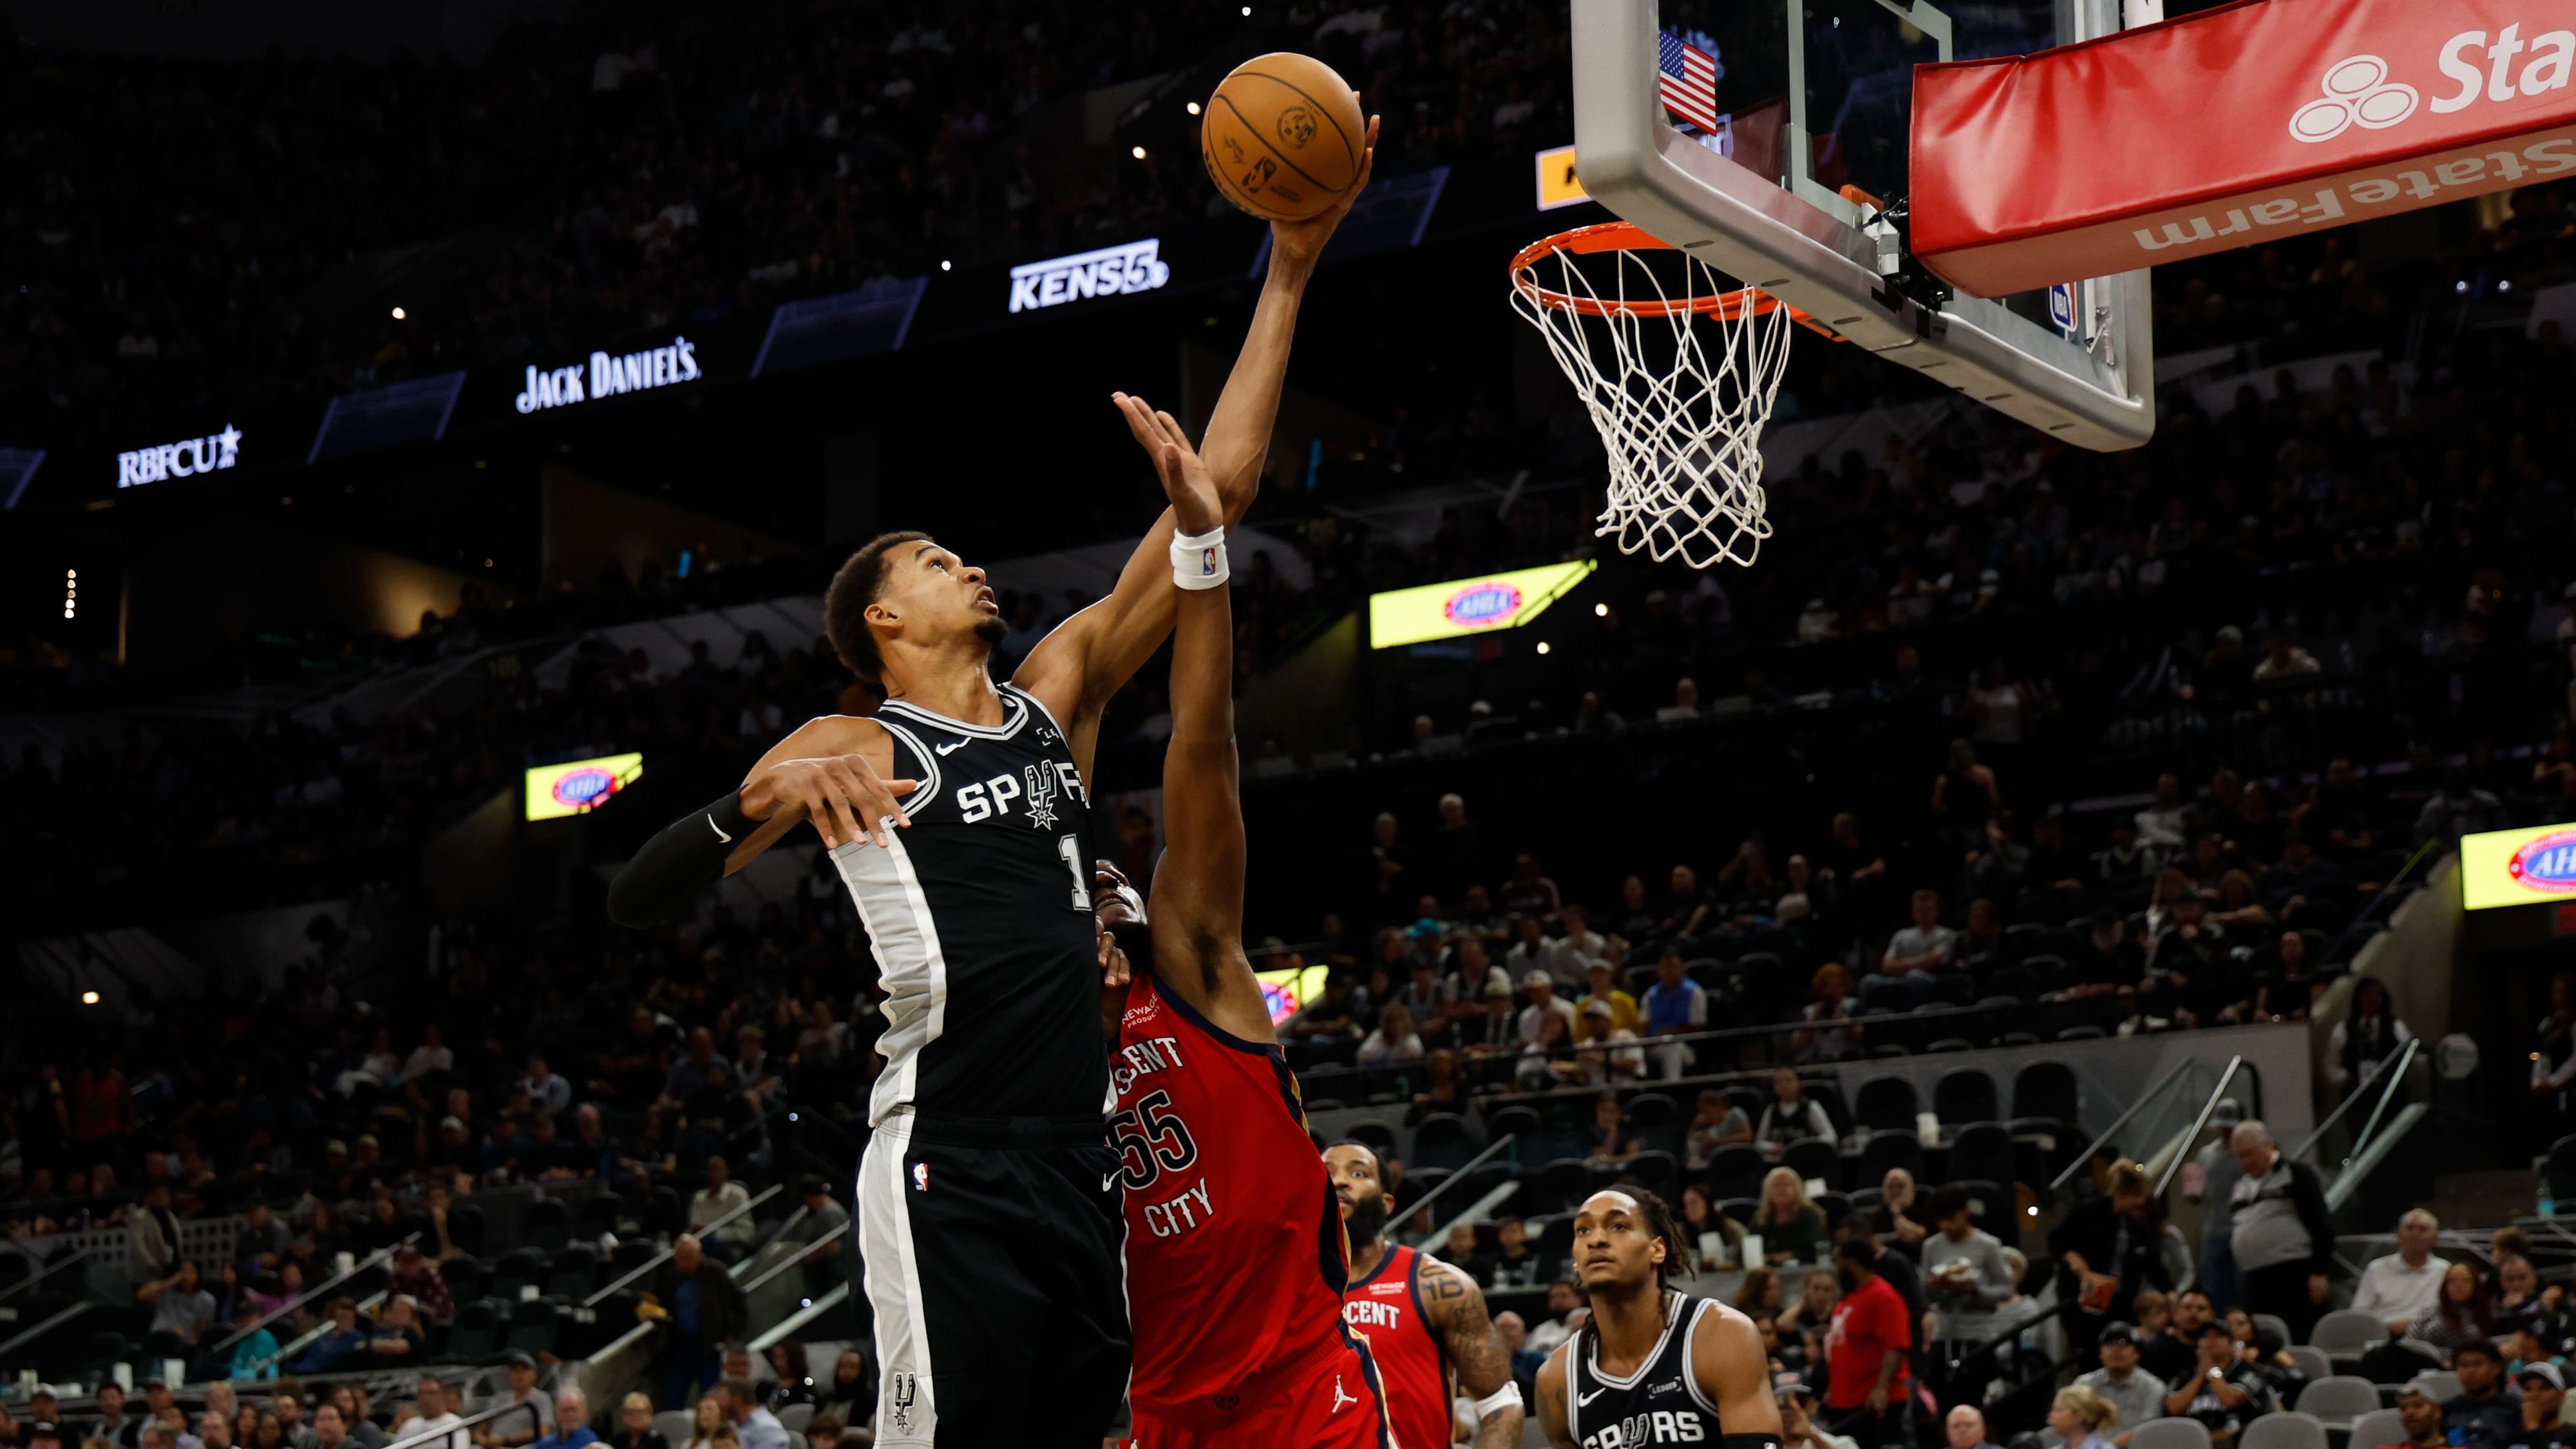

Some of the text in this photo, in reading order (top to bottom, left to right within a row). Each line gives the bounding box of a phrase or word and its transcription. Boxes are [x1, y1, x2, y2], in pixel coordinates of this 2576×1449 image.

[516, 336, 697, 413] JACK DANIEL'S
[117, 435, 219, 488] RBFCU
[1058, 833, 1092, 911] 1
[1127, 1005, 1160, 1029] PRODUCTS
[1105, 1090, 1197, 1190] 55
[1144, 1177, 1213, 1236] CITY
